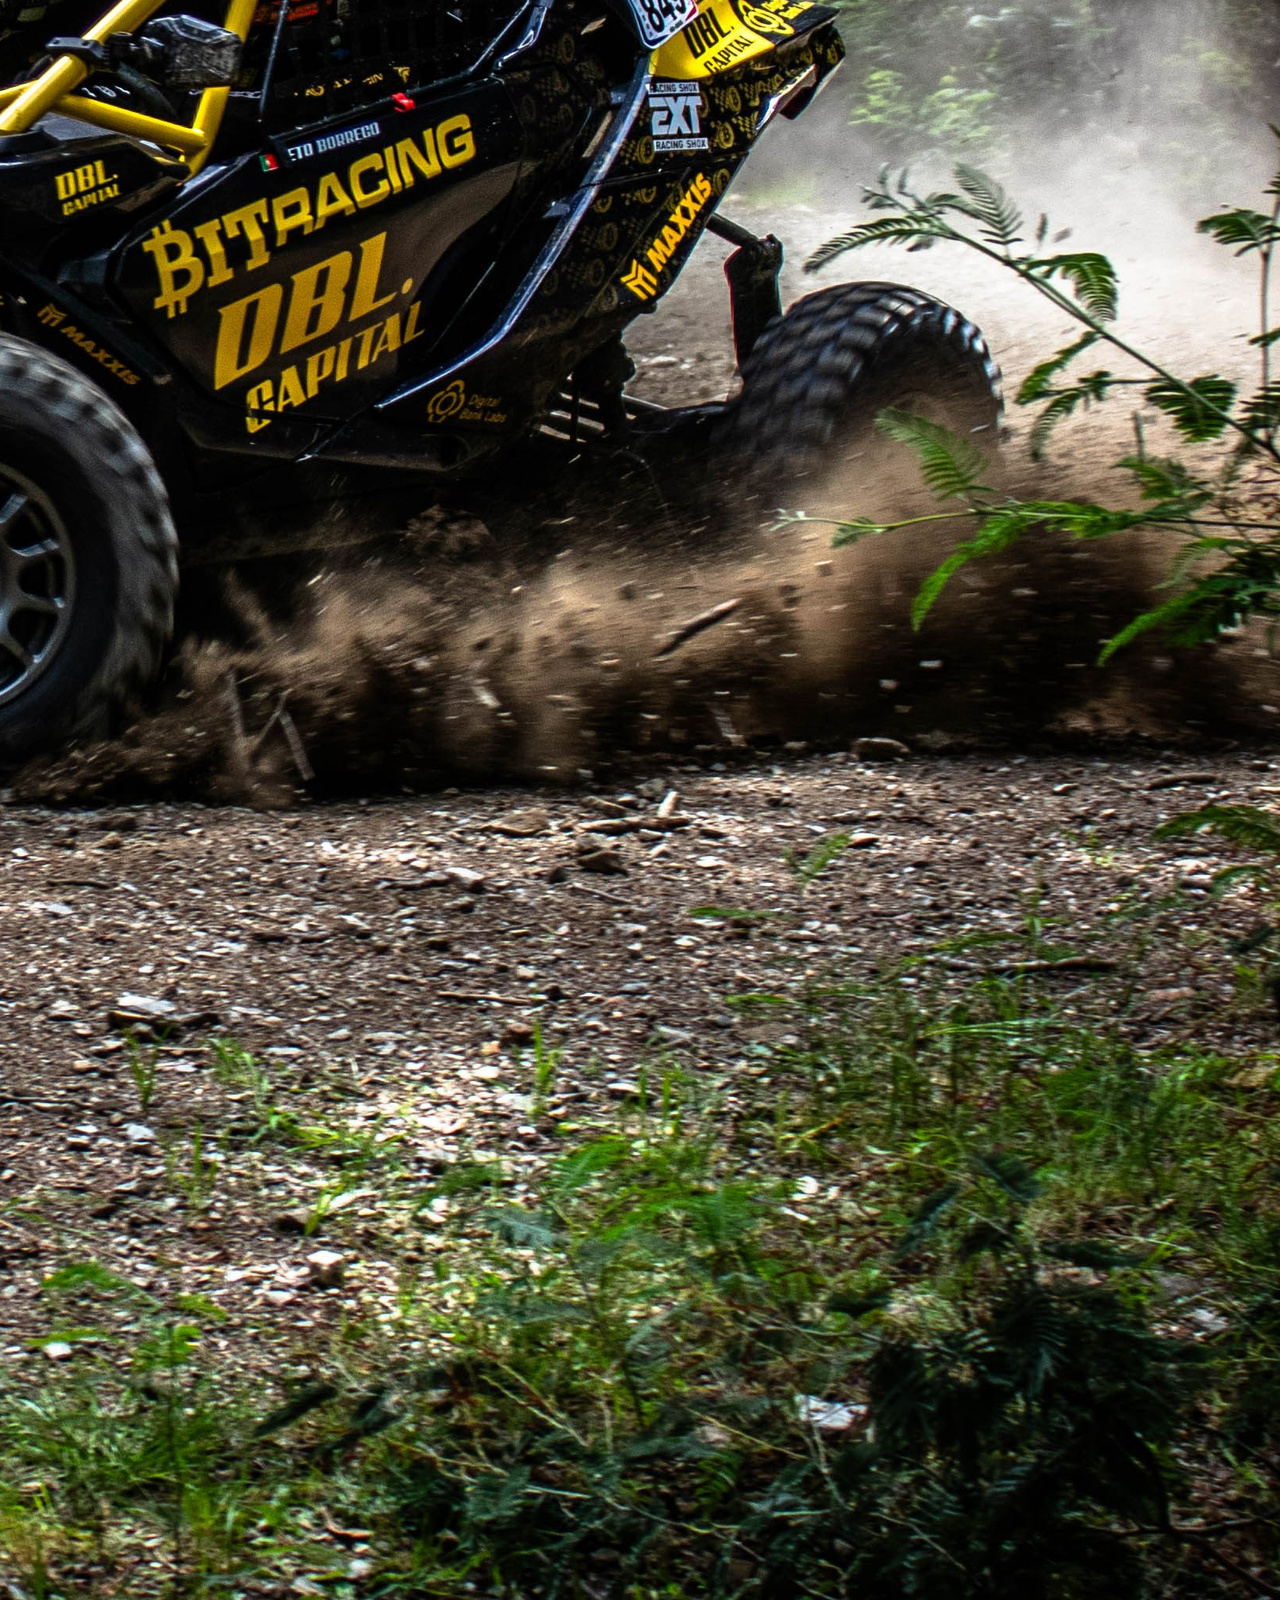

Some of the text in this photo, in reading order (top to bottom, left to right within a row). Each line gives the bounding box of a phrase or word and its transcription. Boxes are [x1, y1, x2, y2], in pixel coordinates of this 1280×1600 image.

[703, 34, 754, 74] CAPITAL
[679, 83, 698, 92] SHOX
[649, 95, 703, 136] EXT
[317, 121, 382, 154] BORREGO
[655, 139, 707, 150] RACING SHOX
[54, 159, 119, 201] DBL.
[62, 184, 123, 216] CAPITAL
[143, 113, 477, 318] BITRACING
[646, 172, 712, 273] MAXXIS
[214, 232, 414, 391] DBL.
[60, 325, 142, 385] MAXXIS
[245, 303, 425, 434] CAPITAL
[484, 411, 507, 422] Labs
